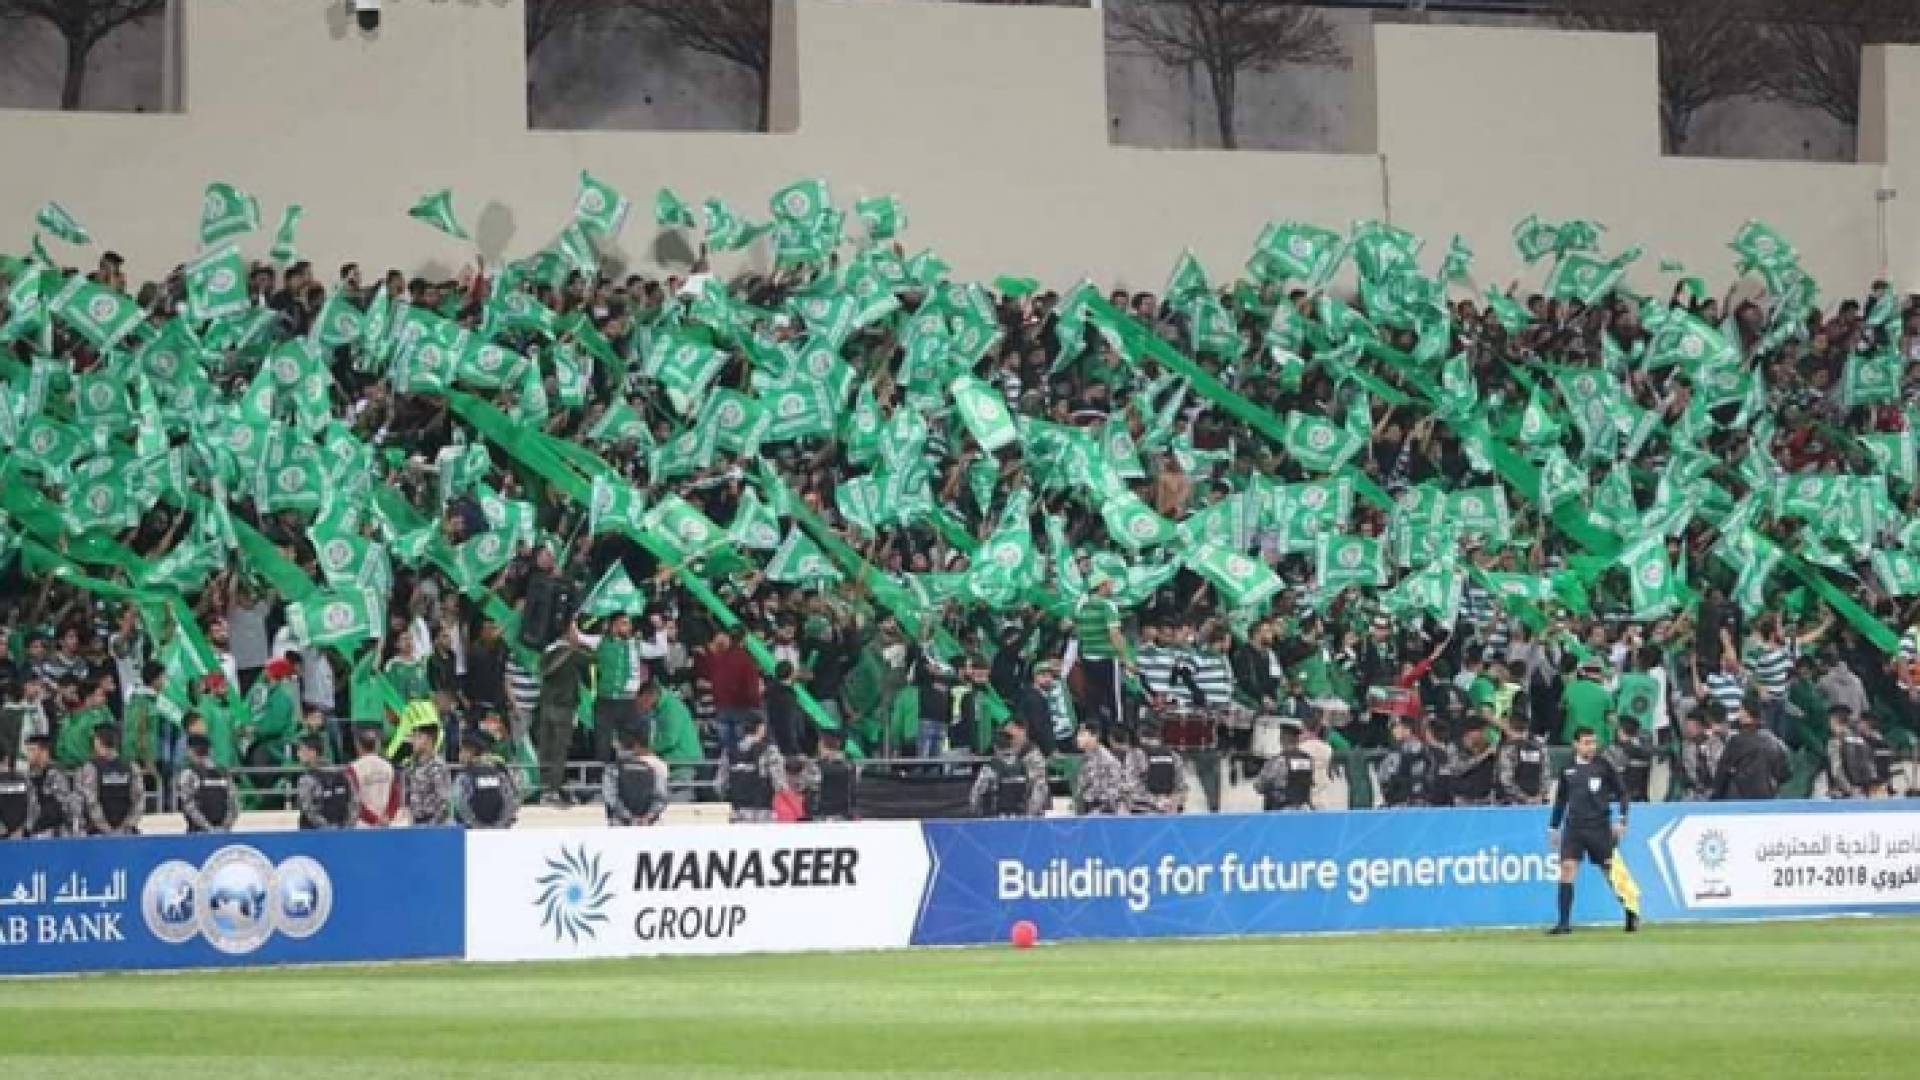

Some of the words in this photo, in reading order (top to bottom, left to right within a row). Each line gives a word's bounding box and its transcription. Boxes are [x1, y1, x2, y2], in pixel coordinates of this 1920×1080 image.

[633, 847, 859, 892] MANASEER
[998, 858, 1150, 911] Building
[1157, 853, 1212, 894] for
[1221, 851, 1338, 893] future
[1346, 844, 1562, 903] generations
[1773, 865, 1867, 887] 2017-2018
[54, 869, 127, 908] البنك
[37, 912, 126, 943] BANK
[634, 906, 746, 941] GROUP
